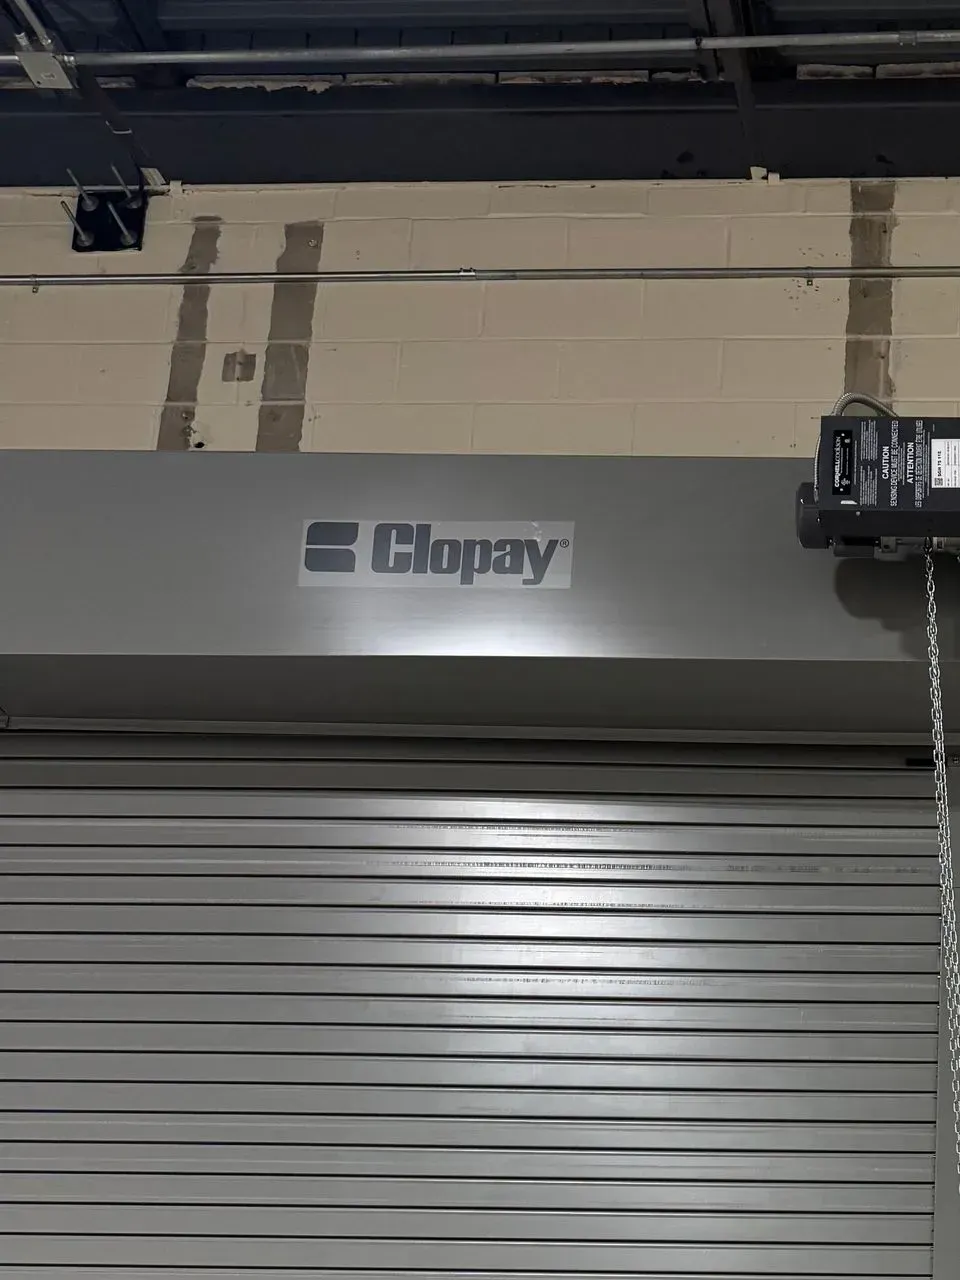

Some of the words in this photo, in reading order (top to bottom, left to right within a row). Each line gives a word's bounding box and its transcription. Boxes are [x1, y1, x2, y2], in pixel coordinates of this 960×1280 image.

[891, 420, 899, 447] CONNECTED
[882, 446, 890, 479] CAUTION
[906, 442, 914, 484] ATTENTION
[890, 469, 898, 486] DEVICE
[890, 486, 898, 507] SENSING
